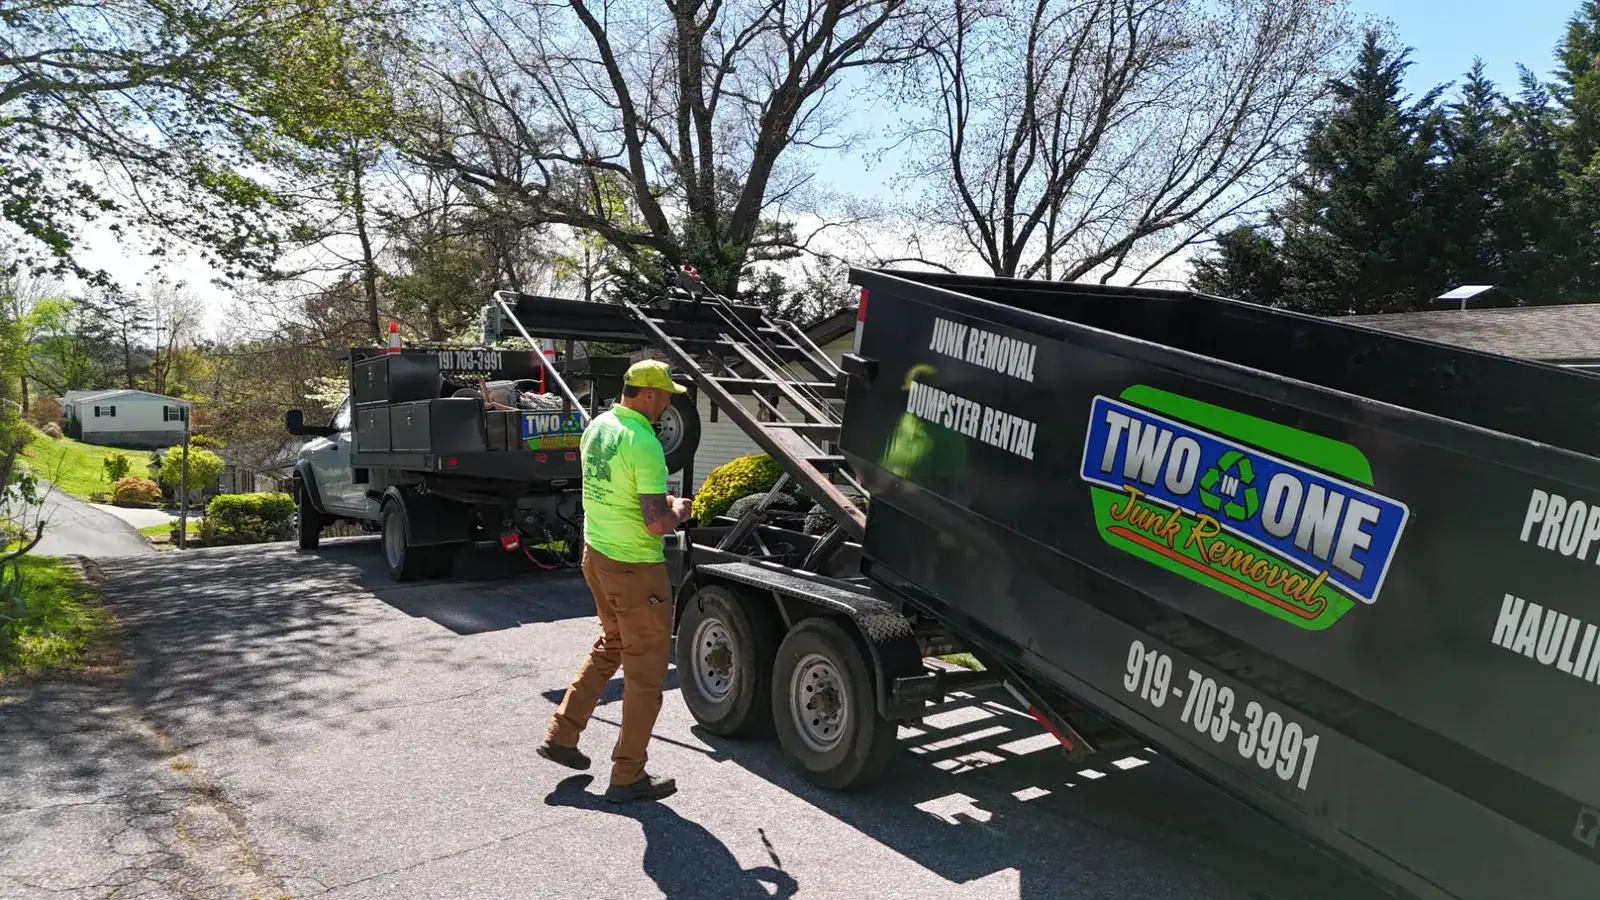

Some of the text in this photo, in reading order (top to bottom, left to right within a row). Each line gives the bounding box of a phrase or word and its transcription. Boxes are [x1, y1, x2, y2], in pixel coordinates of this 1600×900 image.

[456, 351, 502, 370] 703-3991
[929, 317, 1037, 383] JUNK REMOVAL
[526, 414, 560, 434] TWO
[906, 380, 1037, 461] DUMPSTER RENTAL
[1100, 409, 1382, 581] TWO IN ONE
[1520, 488, 1600, 566] PROP
[1110, 484, 1329, 607] Junk Removal
